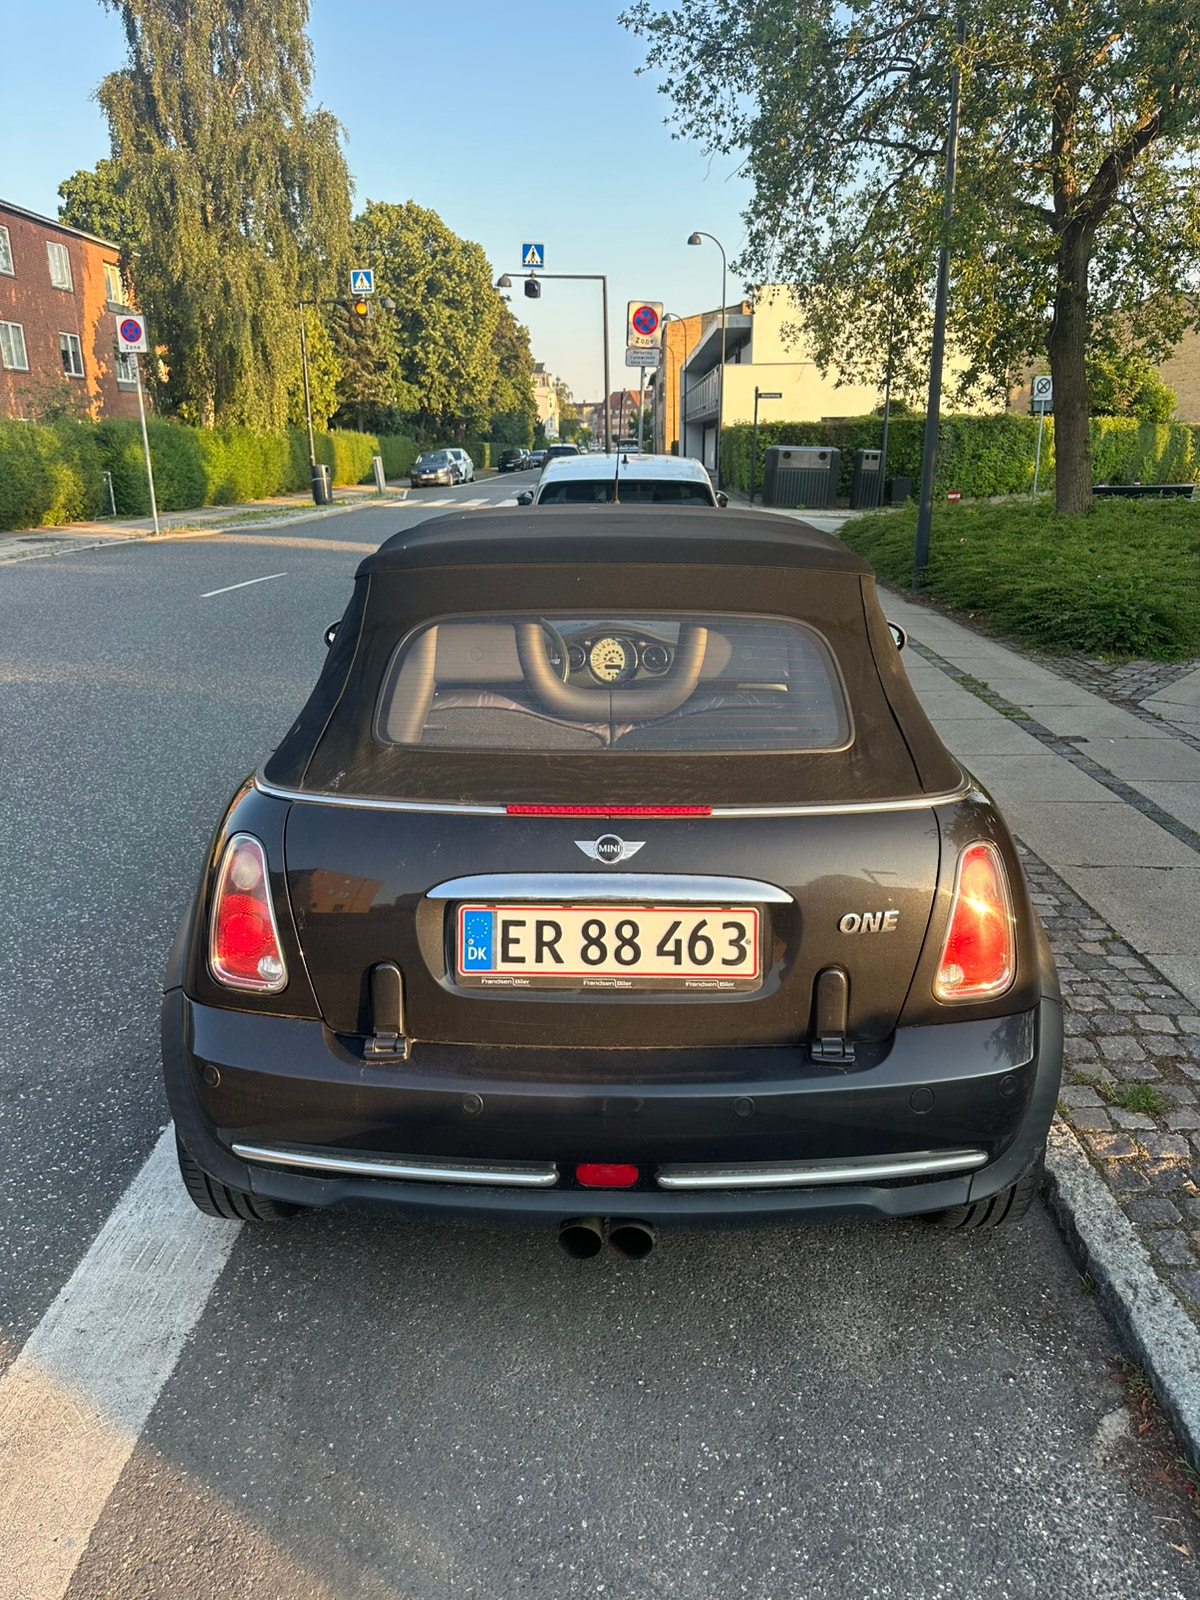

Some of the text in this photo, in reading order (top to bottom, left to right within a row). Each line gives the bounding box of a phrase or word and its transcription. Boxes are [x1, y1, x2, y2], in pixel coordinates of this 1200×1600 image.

[635, 337, 654, 345] Zone
[598, 844, 621, 853] MINI
[837, 910, 899, 934] ONE
[501, 918, 747, 966] ER 88 463
[467, 946, 487, 961] DK
